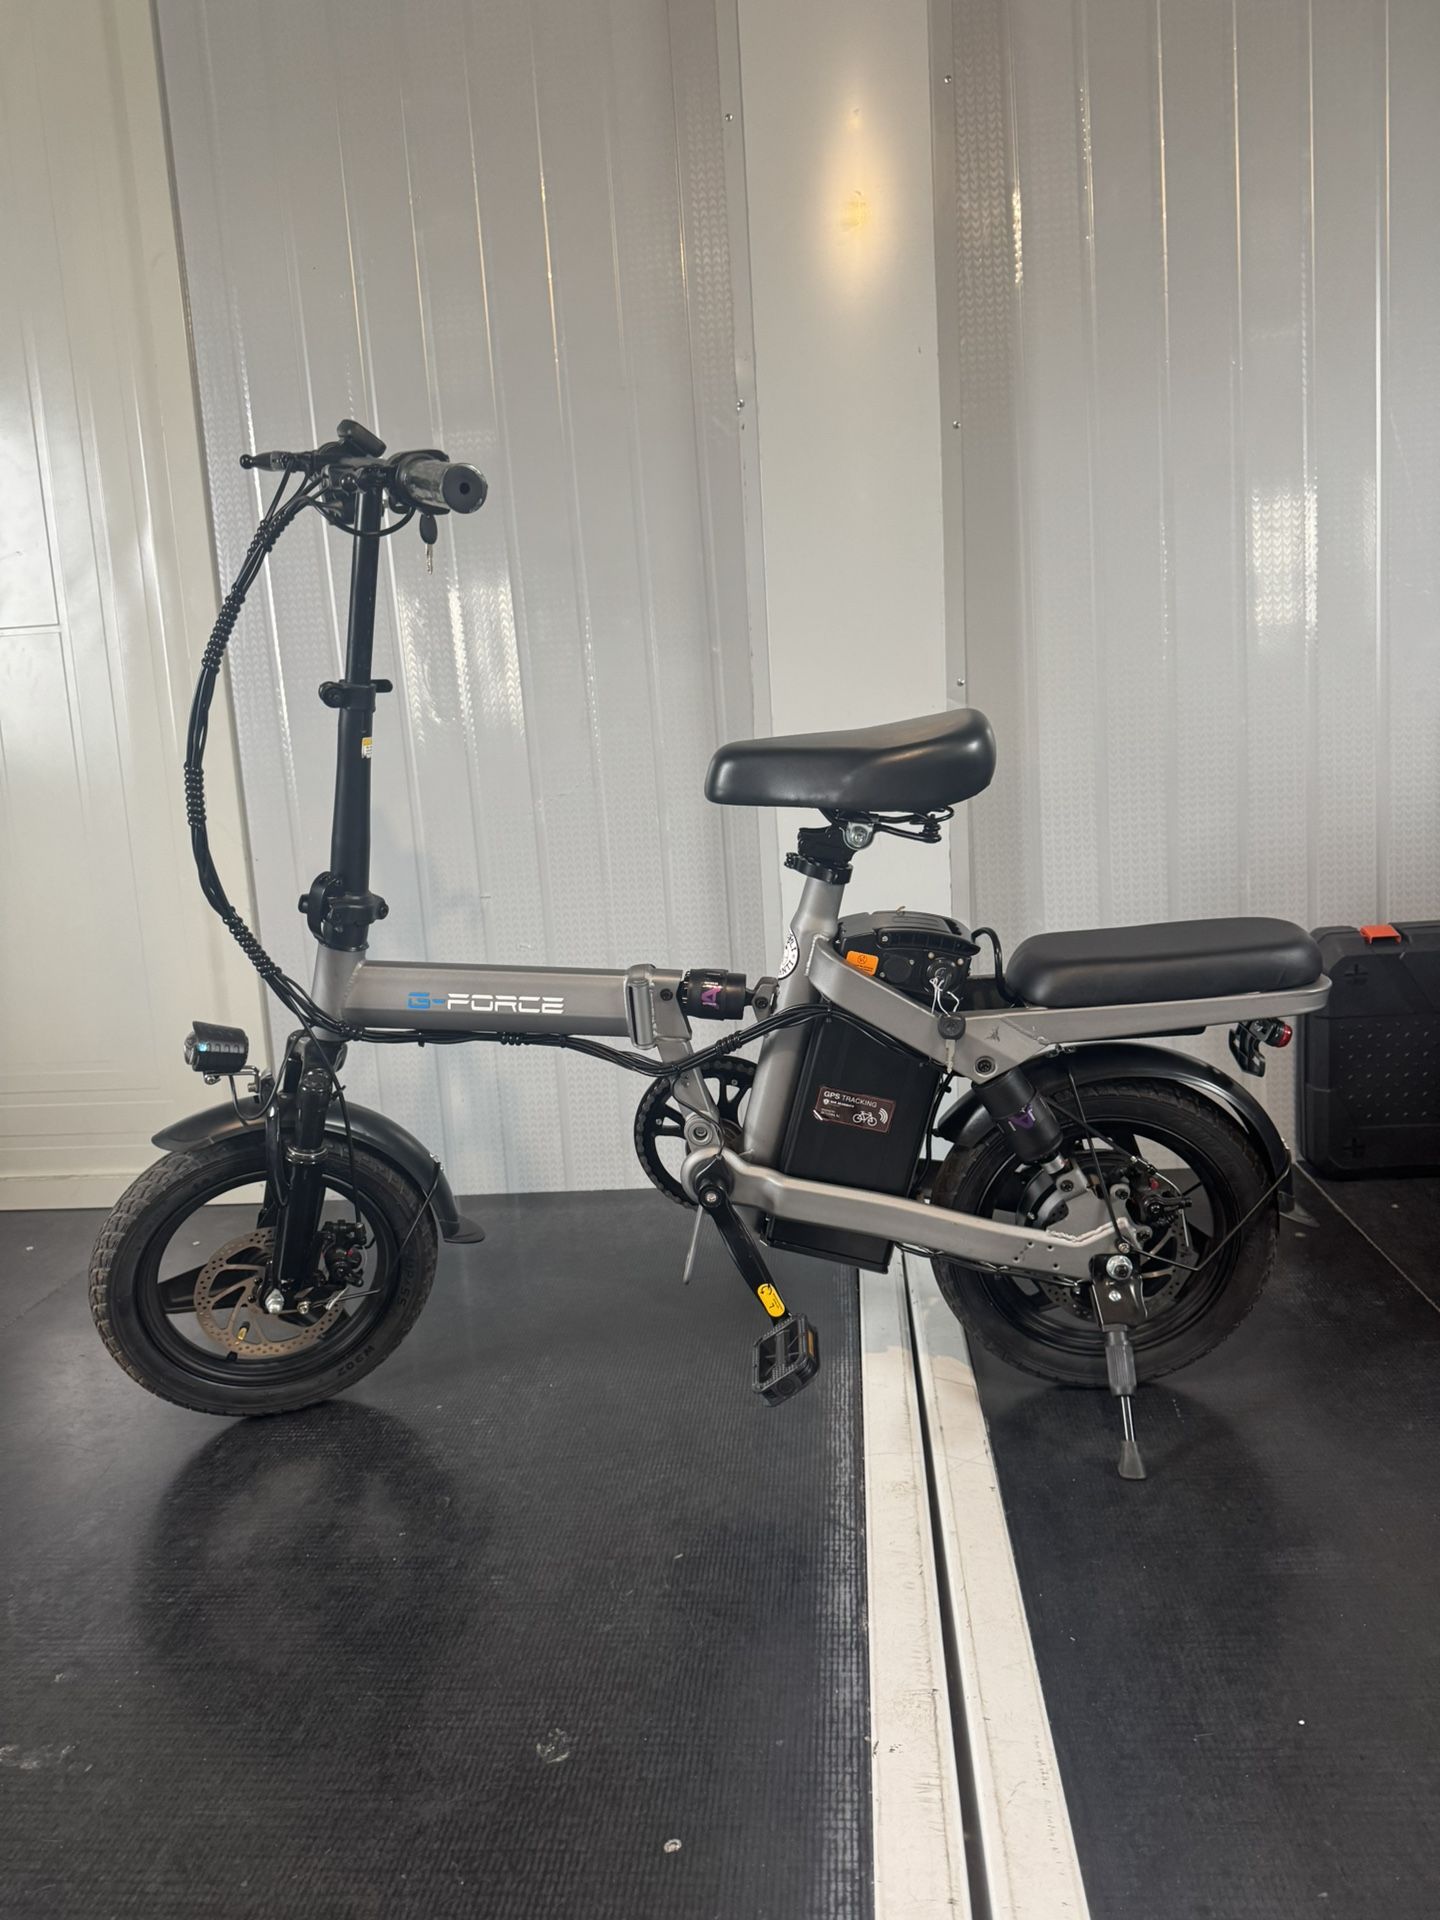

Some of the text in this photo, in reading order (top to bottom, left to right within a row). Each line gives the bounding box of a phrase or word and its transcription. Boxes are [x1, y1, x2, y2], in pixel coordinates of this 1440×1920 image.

[407, 992, 564, 1014] G-FORCE
[824, 1091, 840, 1100] GPS
[842, 1094, 878, 1108] TRACKING
